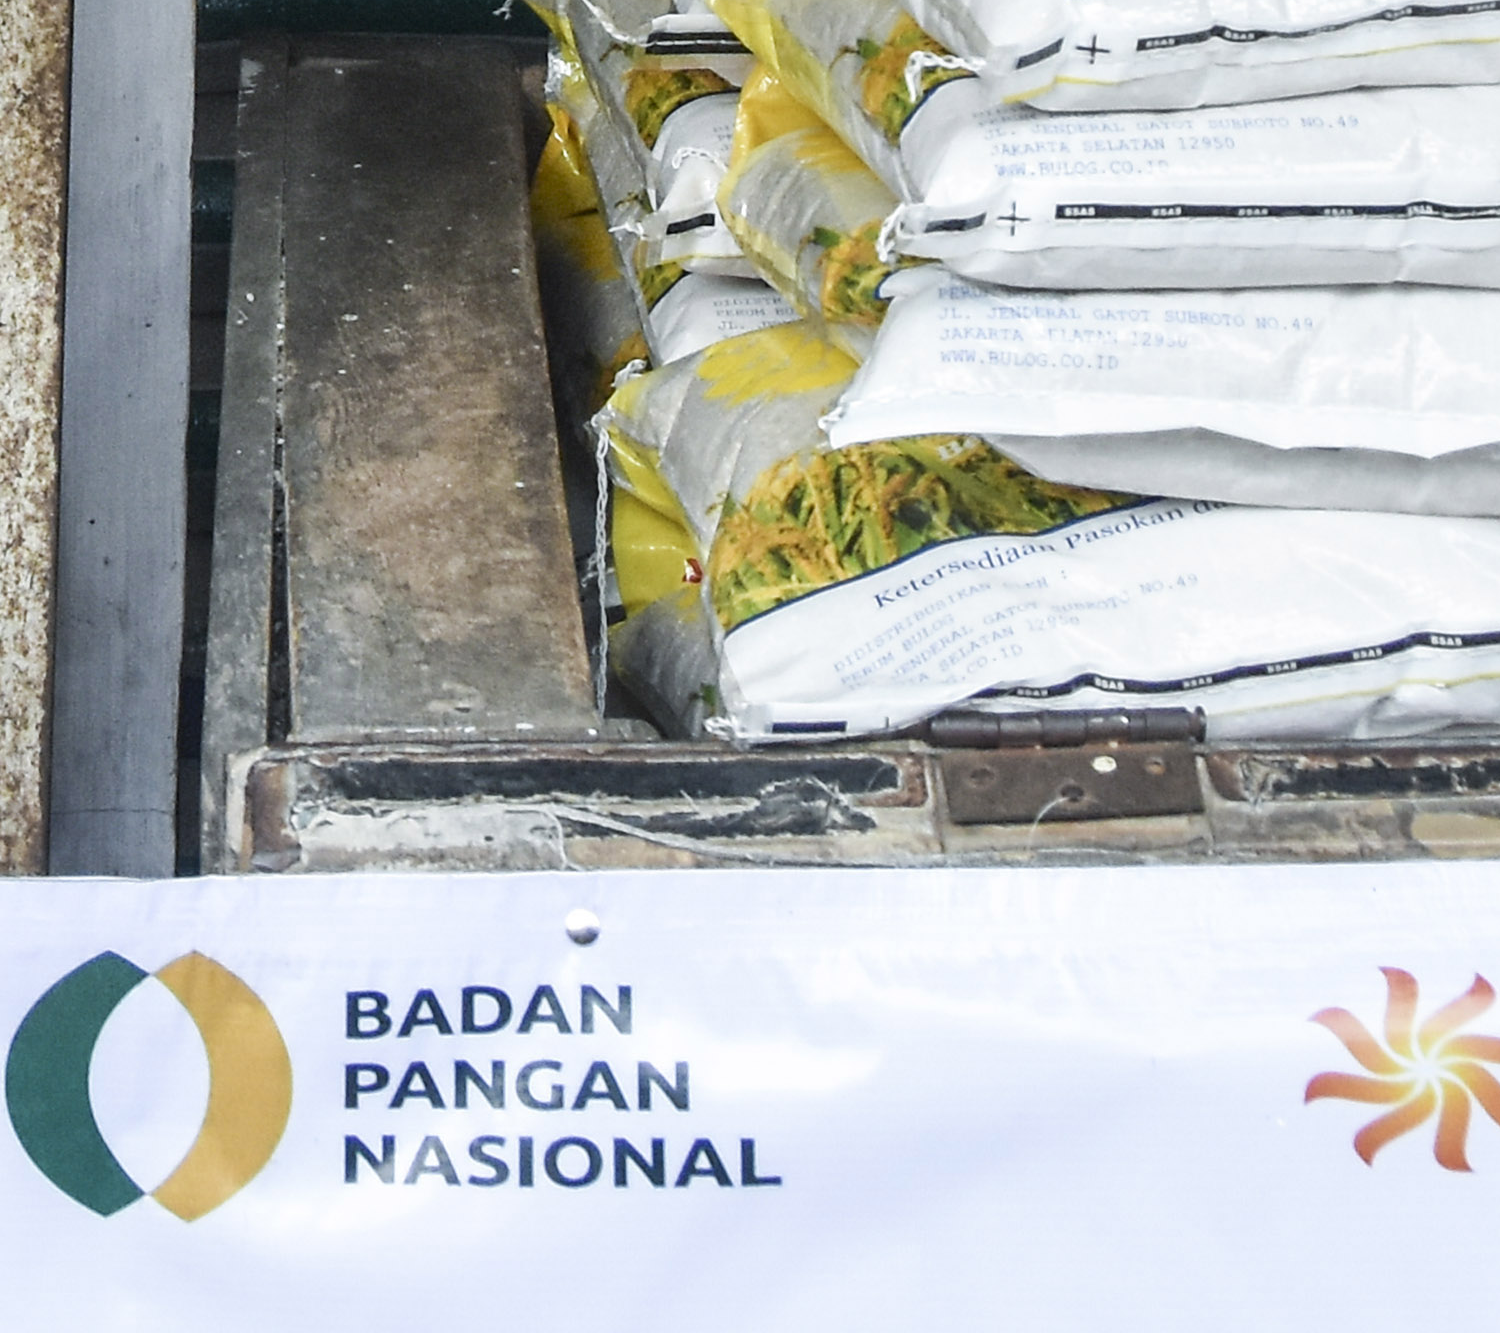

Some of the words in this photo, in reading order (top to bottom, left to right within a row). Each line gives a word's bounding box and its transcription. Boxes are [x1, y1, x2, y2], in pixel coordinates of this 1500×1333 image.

[1299, 114, 1360, 131] NO.49
[990, 139, 1072, 158] JAKARTA
[1081, 136, 1166, 154] SELATAN
[1177, 136, 1236, 152] 12950
[937, 307, 972, 322] JL.
[986, 306, 1082, 322] JENDERAL
[1092, 307, 1151, 323] GATOT
[1163, 309, 1246, 329] SUBROTO
[1254, 315, 1314, 332] NO.49
[939, 327, 1025, 342] JAKARTA
[940, 349, 1120, 371] WWW.BULOG.CO.ID
[873, 541, 1056, 609] Ketersediaan
[1064, 507, 1185, 552] Pasokan
[1138, 572, 1199, 596] NO.49
[900, 612, 958, 652] BULOG
[345, 983, 634, 1041] BADAN
[343, 1059, 691, 1113] PANGAN
[343, 1133, 784, 1189] NASIONAL
